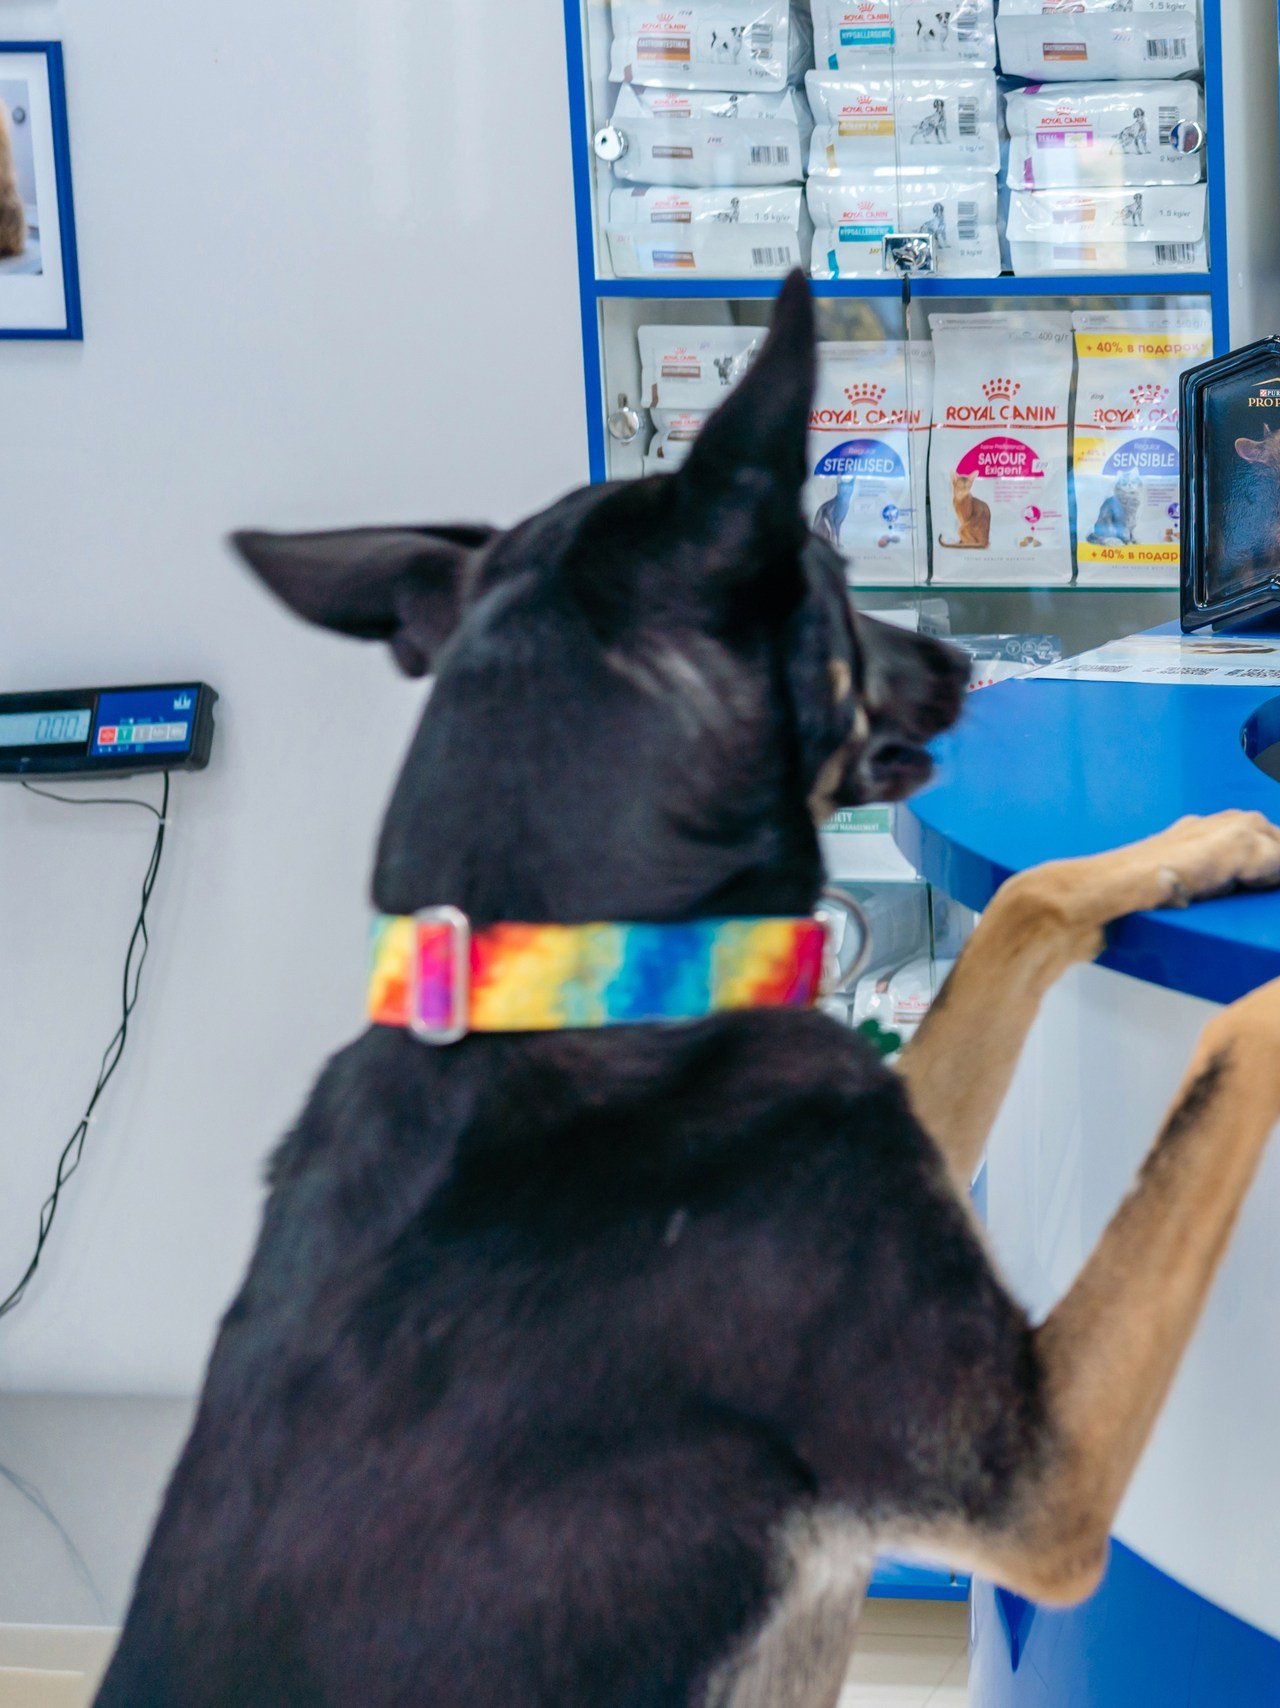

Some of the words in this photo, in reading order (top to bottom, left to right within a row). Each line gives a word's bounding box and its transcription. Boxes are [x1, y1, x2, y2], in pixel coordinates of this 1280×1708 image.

[866, 13, 889, 21] CANIN
[842, 105, 863, 113] ROYAL
[1038, 331, 1053, 341] 400
[1096, 342, 1123, 353] 40%
[1248, 397, 1273, 408] PRO
[809, 409, 860, 425] ROYAL
[865, 409, 920, 425] CANIN
[946, 406, 995, 421] ROYAL
[1000, 405, 1056, 421] CANIN
[978, 452, 1027, 465] SAVOUR
[1113, 452, 1175, 467] SENSIBLE
[823, 457, 895, 473] STERILISED
[984, 465, 1022, 477] Exigent
[1100, 549, 1124, 560] 40%
[1128, 552, 1135, 560] в
[1138, 551, 1180, 562] подар
[840, 823, 879, 831] MANAGEMENT
